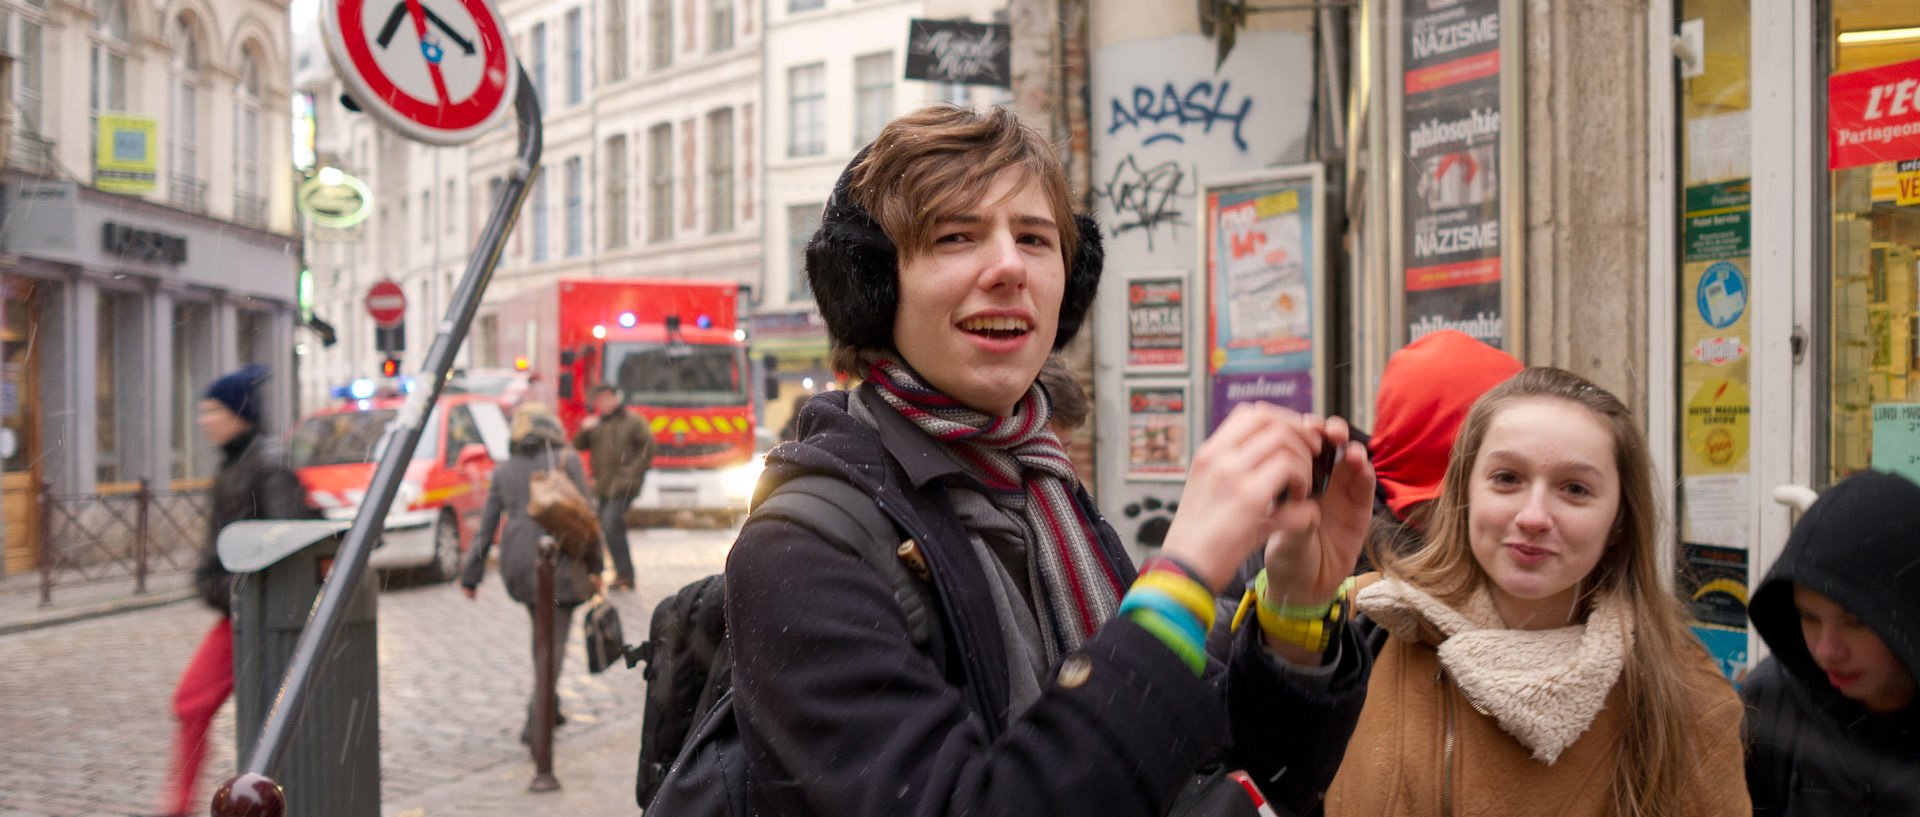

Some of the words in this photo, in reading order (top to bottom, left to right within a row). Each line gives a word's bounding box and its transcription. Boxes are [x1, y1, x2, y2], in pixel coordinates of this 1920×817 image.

[1413, 13, 1498, 59] NAZISME
[1410, 106, 1500, 157] philosophie
[1415, 221, 1498, 257] NAZISME
